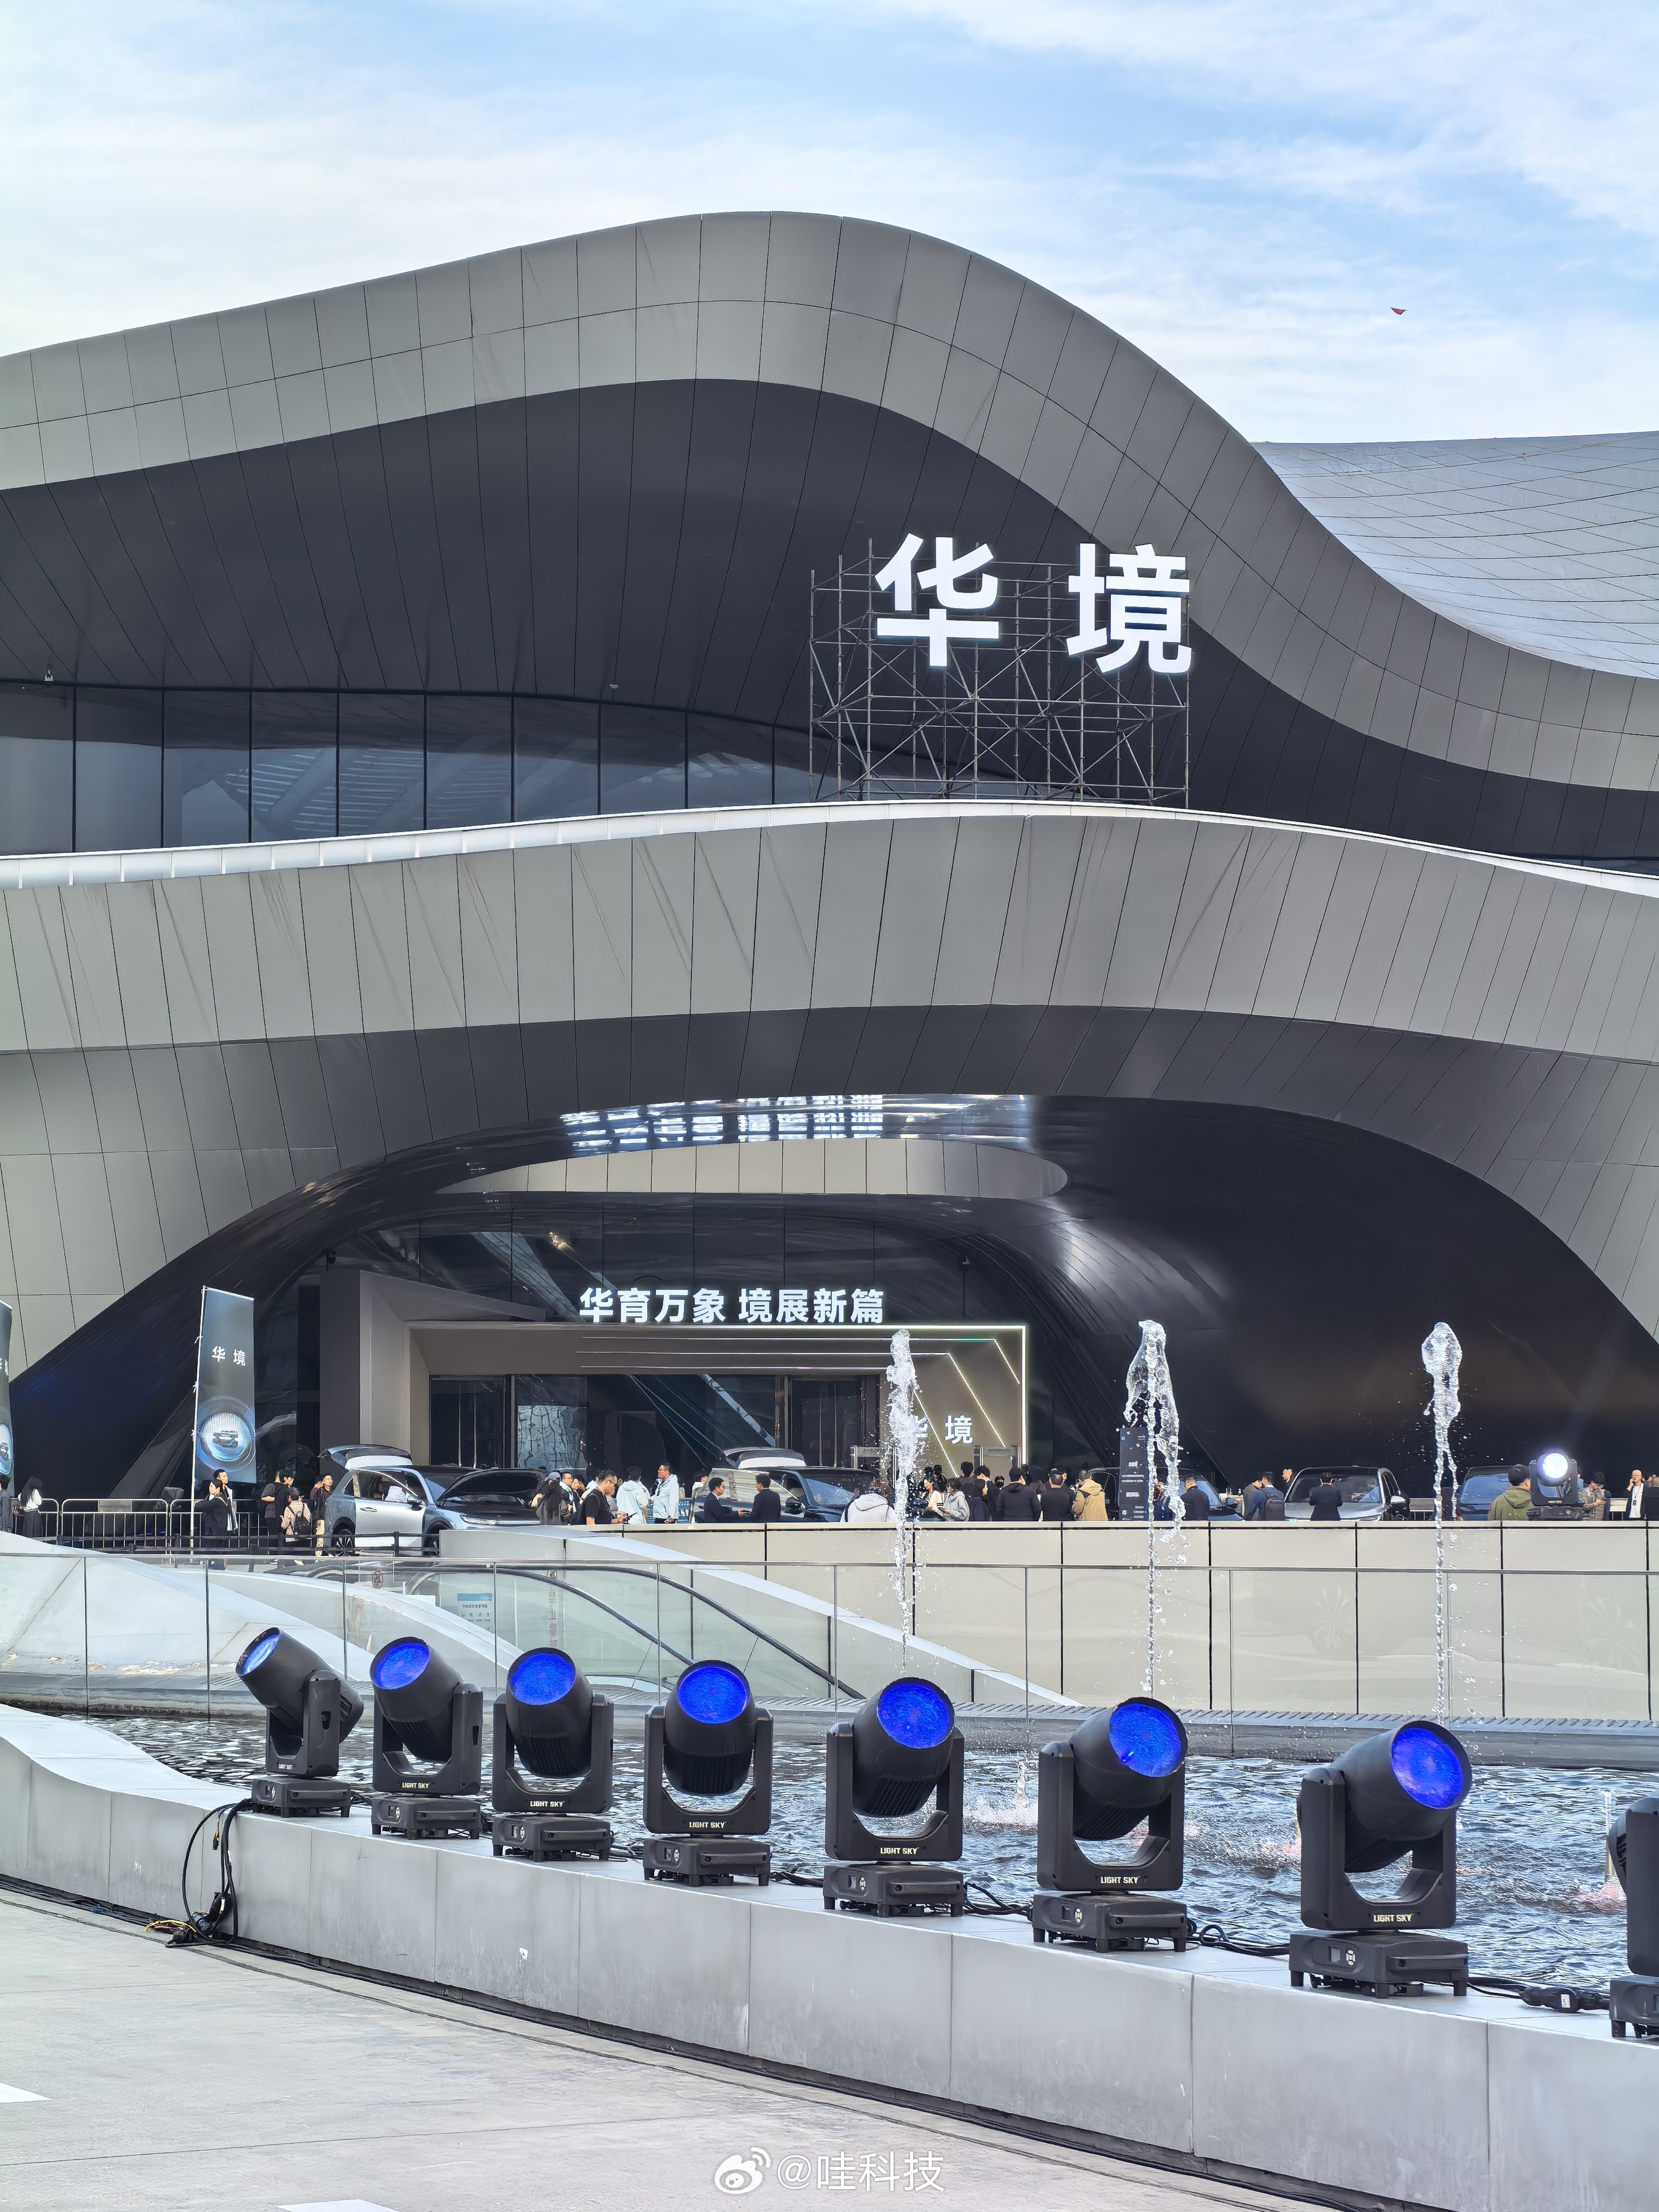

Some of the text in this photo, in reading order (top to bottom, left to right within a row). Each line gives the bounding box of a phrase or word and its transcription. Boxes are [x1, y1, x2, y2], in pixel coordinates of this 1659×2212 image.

[579, 1287, 884, 1324] 华育万象 境展新篇
[212, 1346, 246, 1366] 华境
[1396, 1914, 1412, 1922] SKY
